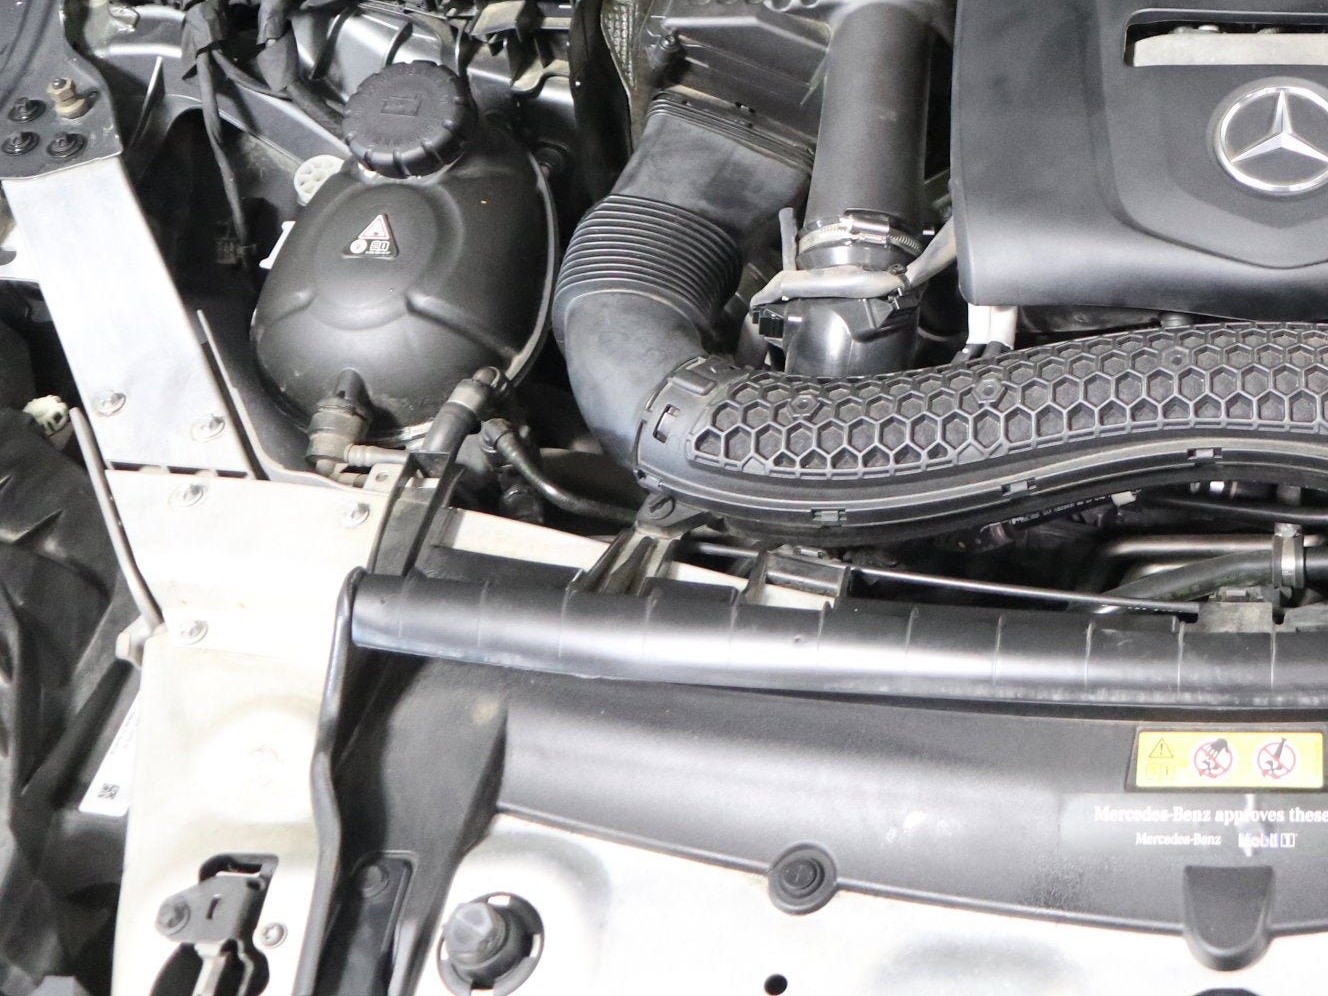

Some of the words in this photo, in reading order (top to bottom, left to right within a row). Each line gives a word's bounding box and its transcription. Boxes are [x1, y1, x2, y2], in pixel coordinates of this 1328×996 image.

[1094, 805, 1212, 822] Mercedes-Benz
[1215, 808, 1285, 825] approves
[1135, 832, 1222, 845] Mercedes-Benz
